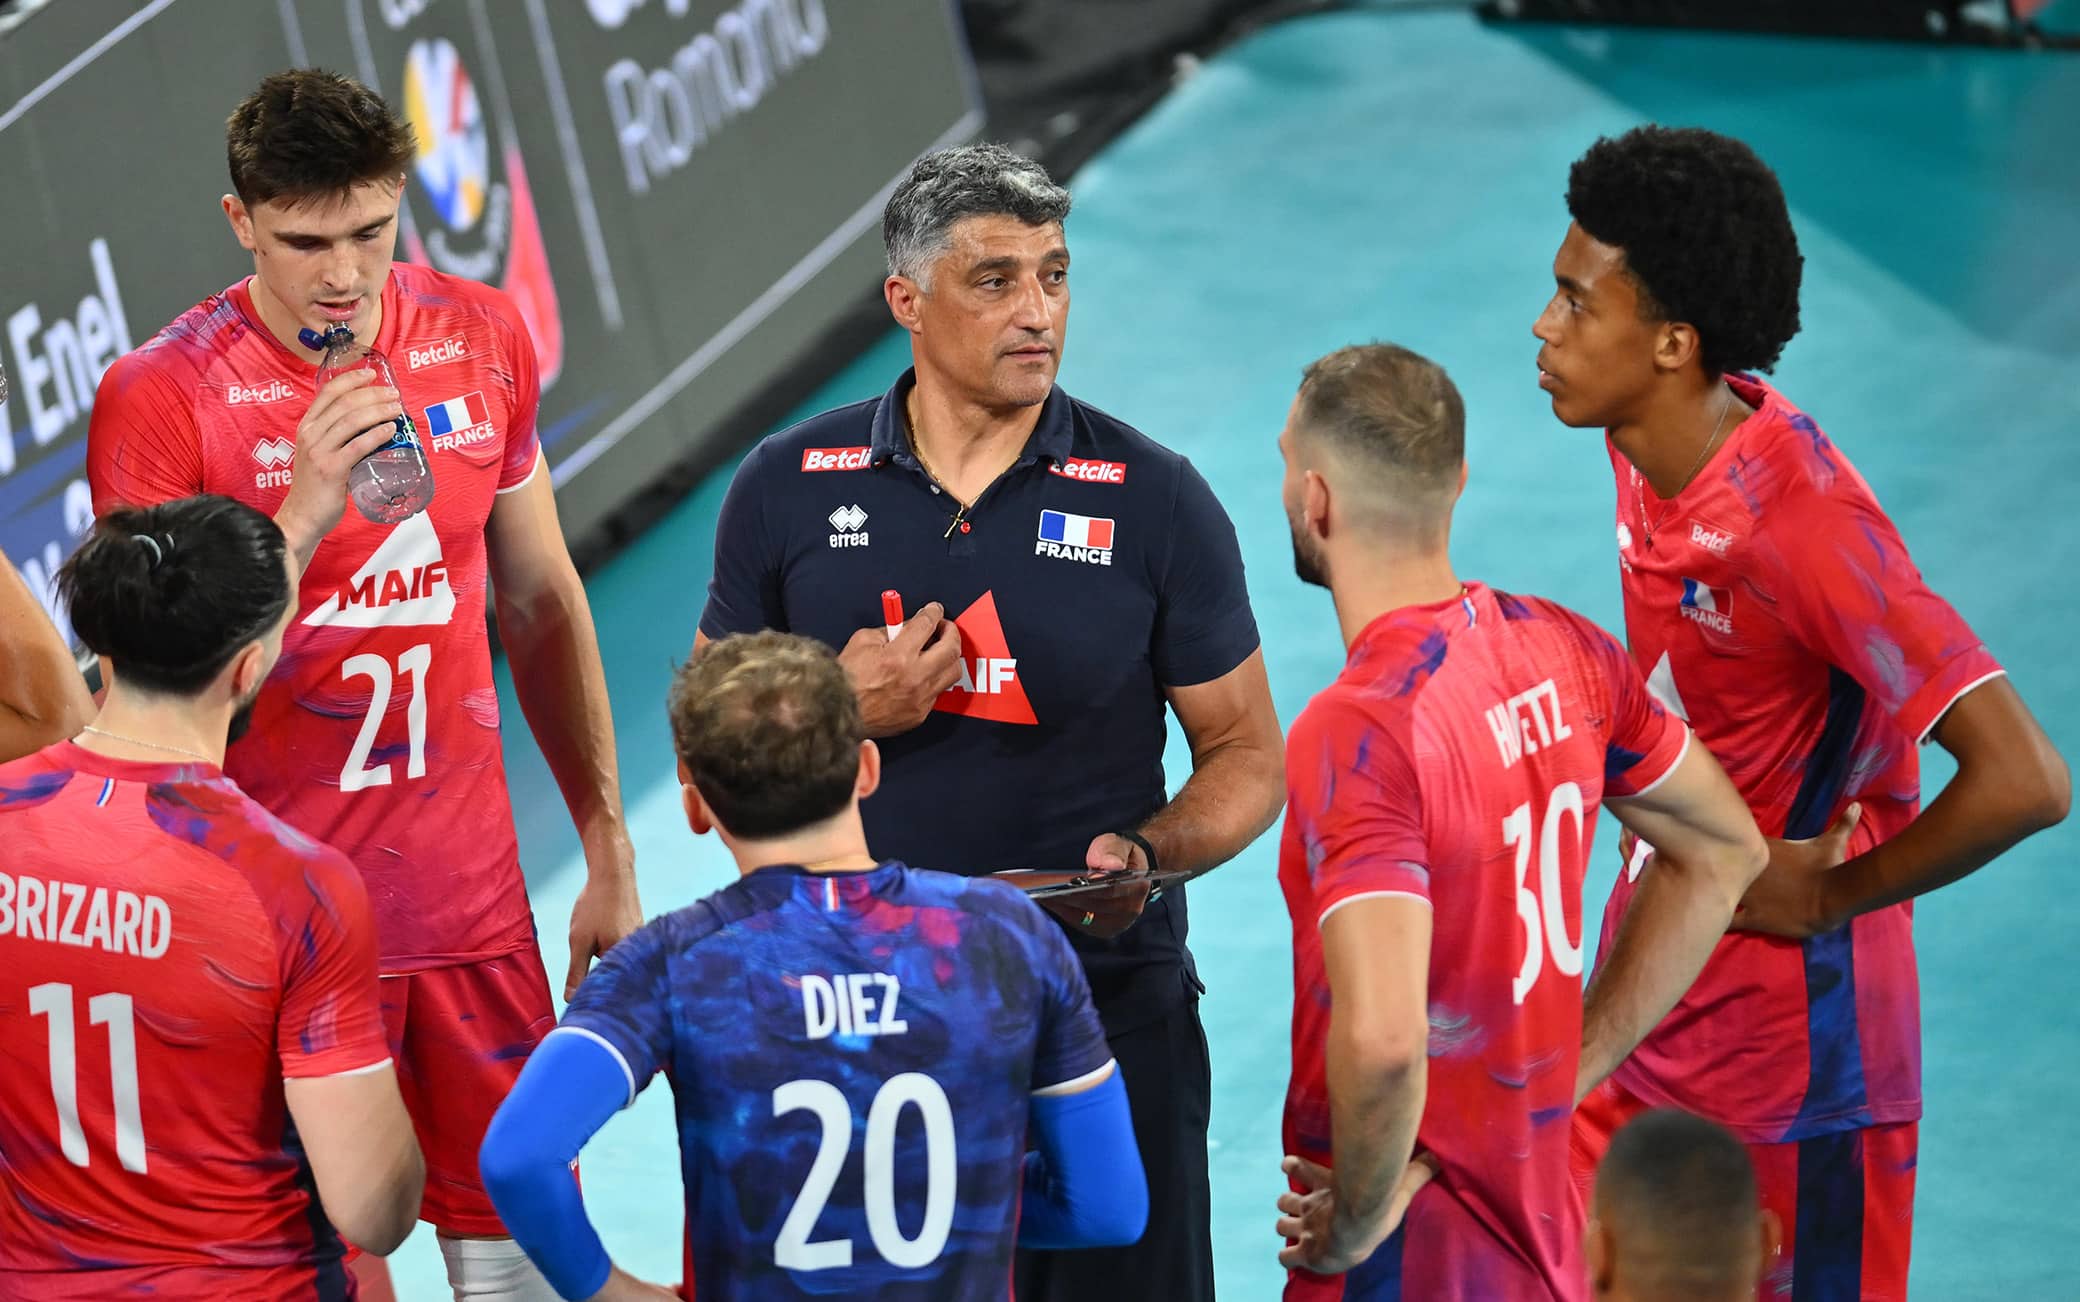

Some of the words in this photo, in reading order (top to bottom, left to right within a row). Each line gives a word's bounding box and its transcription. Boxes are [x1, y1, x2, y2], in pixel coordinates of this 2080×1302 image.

[7, 236, 134, 447] Enel
[408, 338, 467, 370] Betclic
[227, 380, 295, 405] Betclic
[432, 423, 495, 453] FRANCE
[804, 447, 873, 470] Betcli
[1050, 460, 1122, 482] etclic
[255, 469, 294, 489] erre
[829, 531, 869, 548] errea
[1035, 541, 1113, 566] FRANCE
[336, 560, 449, 612] MAIF
[1680, 605, 1732, 635] FRANCE
[945, 656, 1017, 694] AIF
[340, 643, 432, 793] 21
[1502, 780, 1585, 1006] 30
[801, 971, 908, 1040] DIEZ
[28, 981, 148, 1175] 11
[772, 1071, 958, 1272] 20
